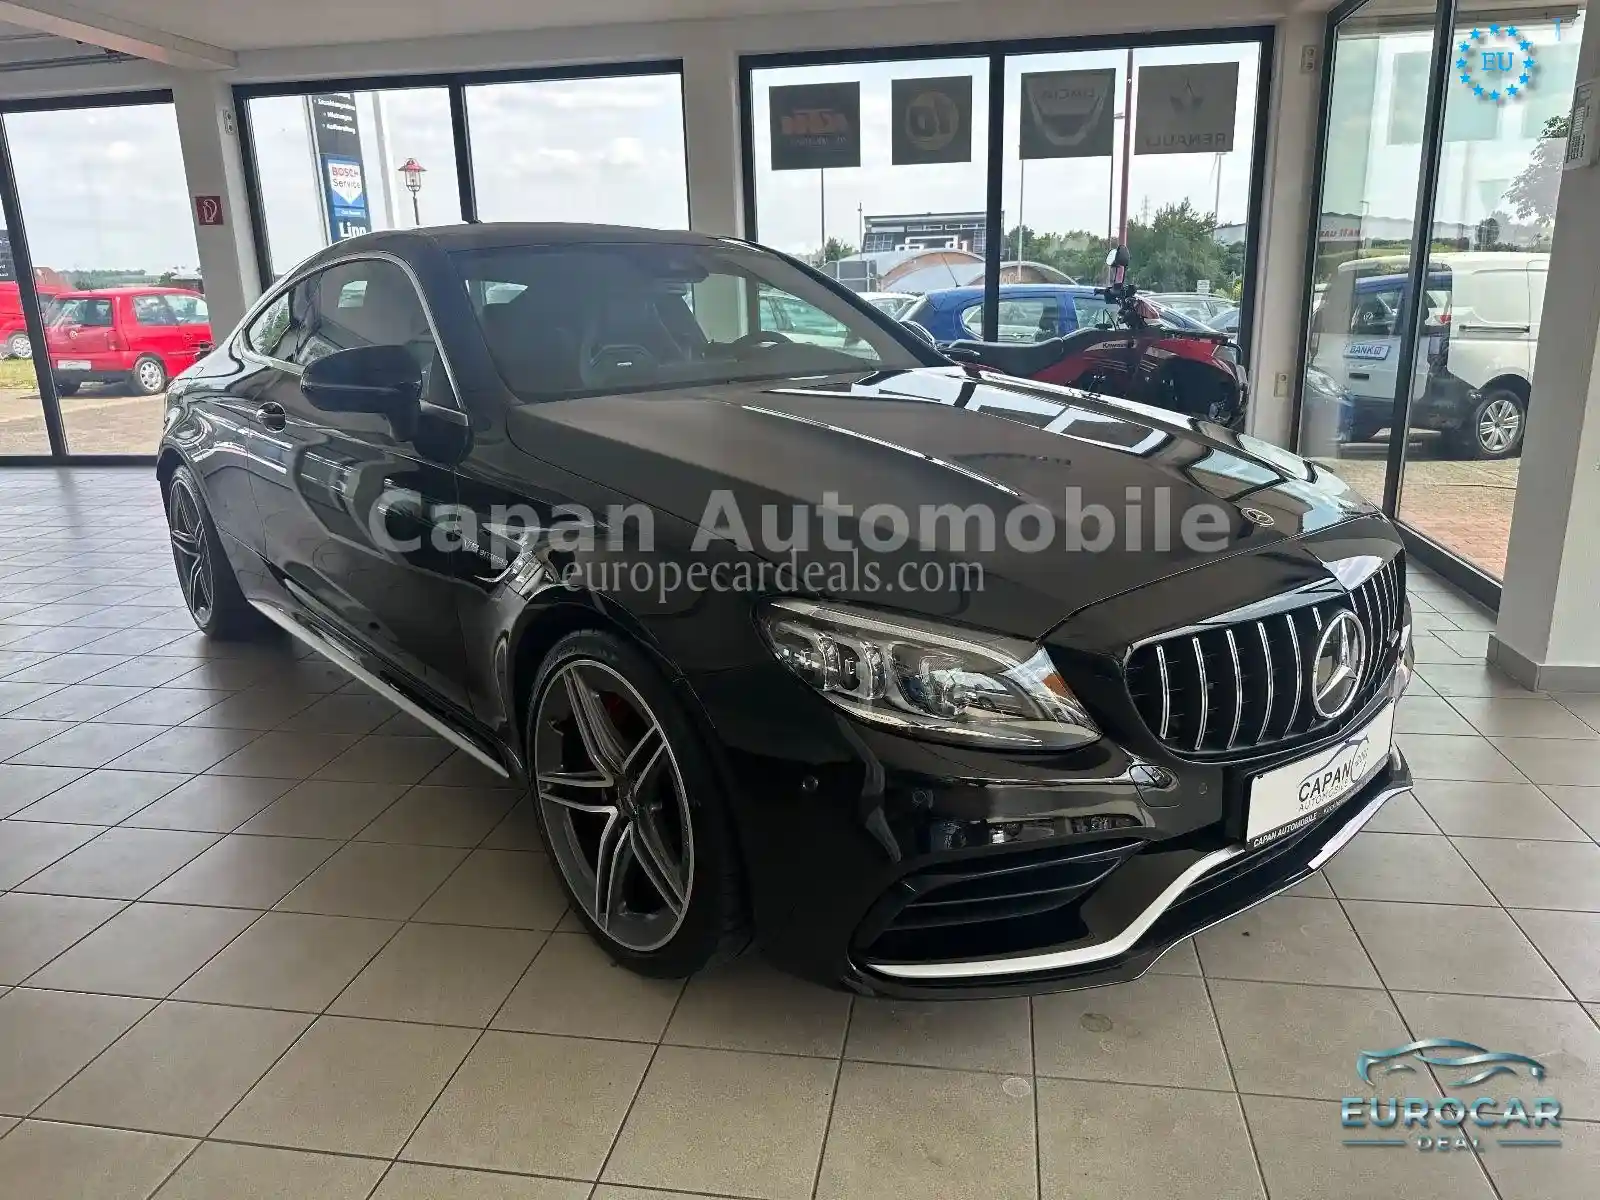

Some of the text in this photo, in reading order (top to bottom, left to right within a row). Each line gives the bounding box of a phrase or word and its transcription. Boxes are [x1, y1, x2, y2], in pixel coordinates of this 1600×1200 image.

[331, 166, 359, 178] BOSCH
[333, 179, 361, 189] Service
[1298, 760, 1352, 803] CAPAN
[1253, 811, 1318, 848] CAPAN AUTOMOBILE
